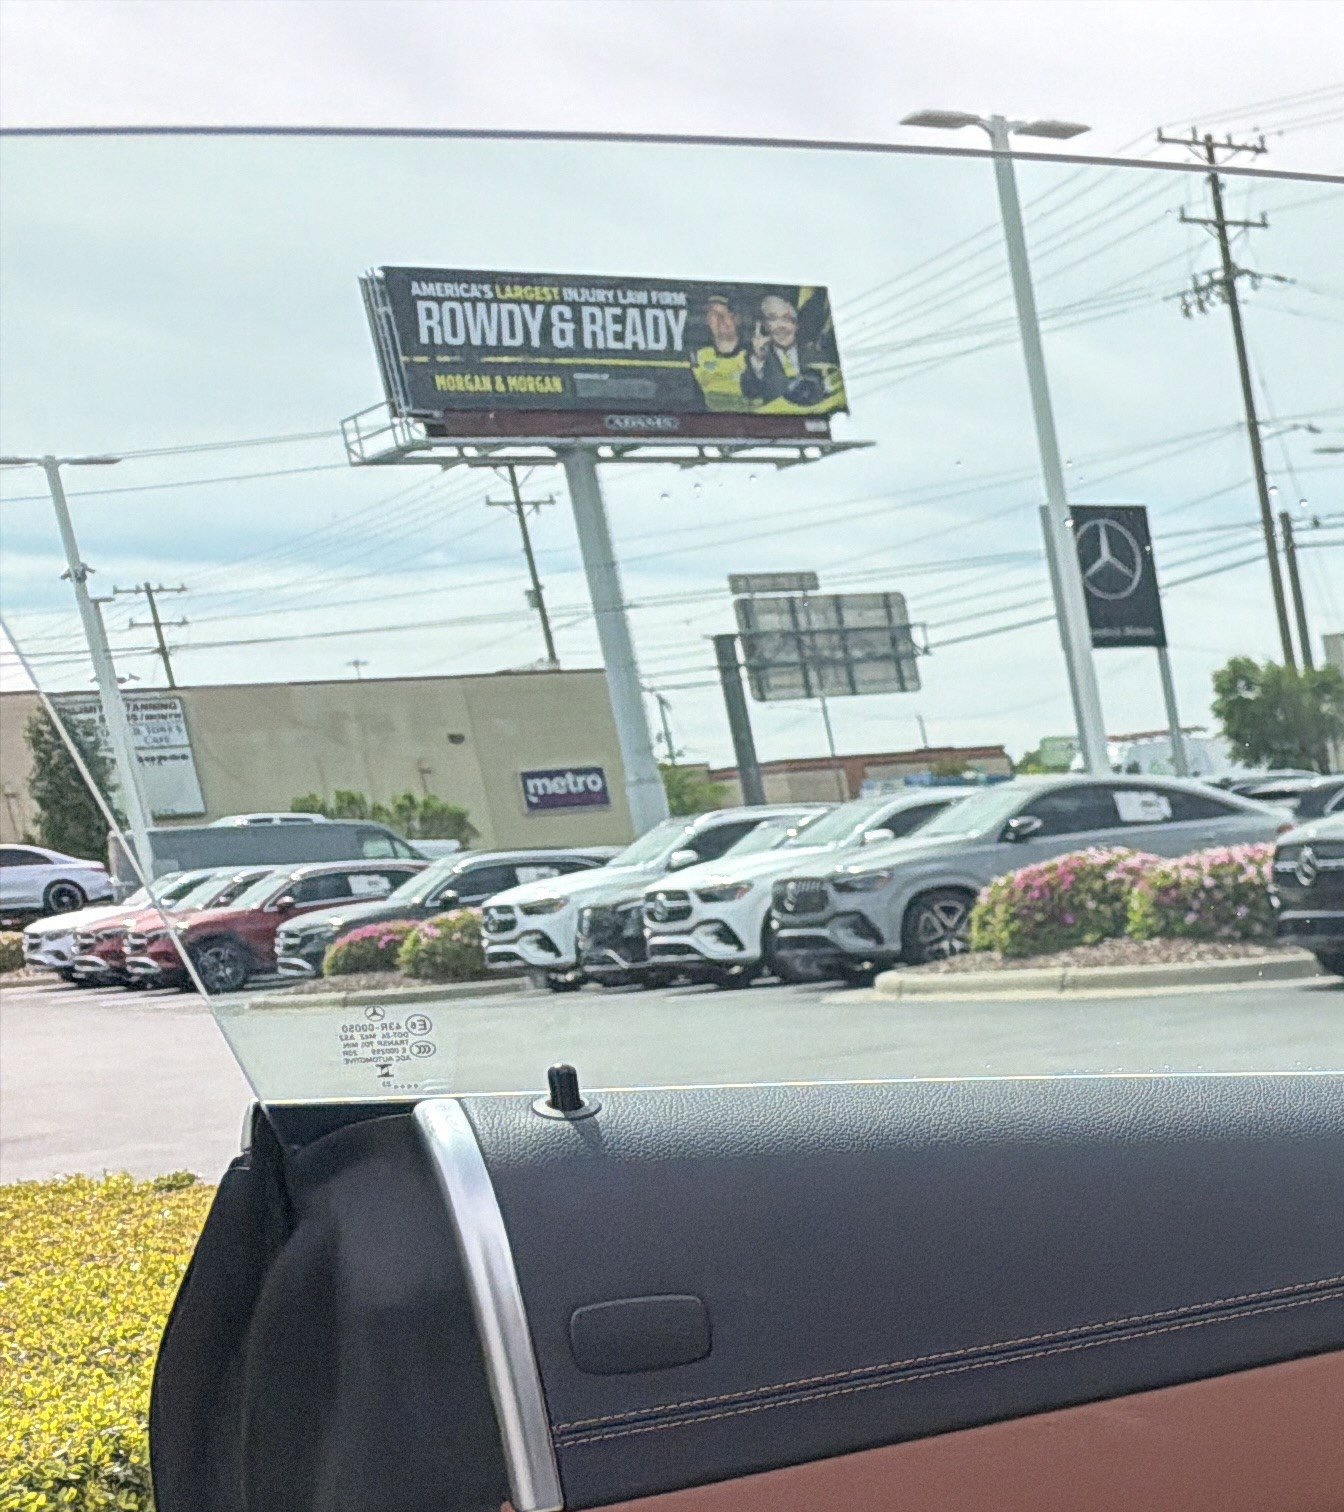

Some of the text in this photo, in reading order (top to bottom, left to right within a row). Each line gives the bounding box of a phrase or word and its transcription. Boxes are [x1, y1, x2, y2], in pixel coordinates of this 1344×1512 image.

[411, 281, 687, 307] AMERICA'S LARGEST INJURY LAW FIRM
[417, 300, 688, 352] ROWDY & READY
[435, 373, 563, 393] MORGAN & MORGAN
[526, 771, 603, 796] metro
